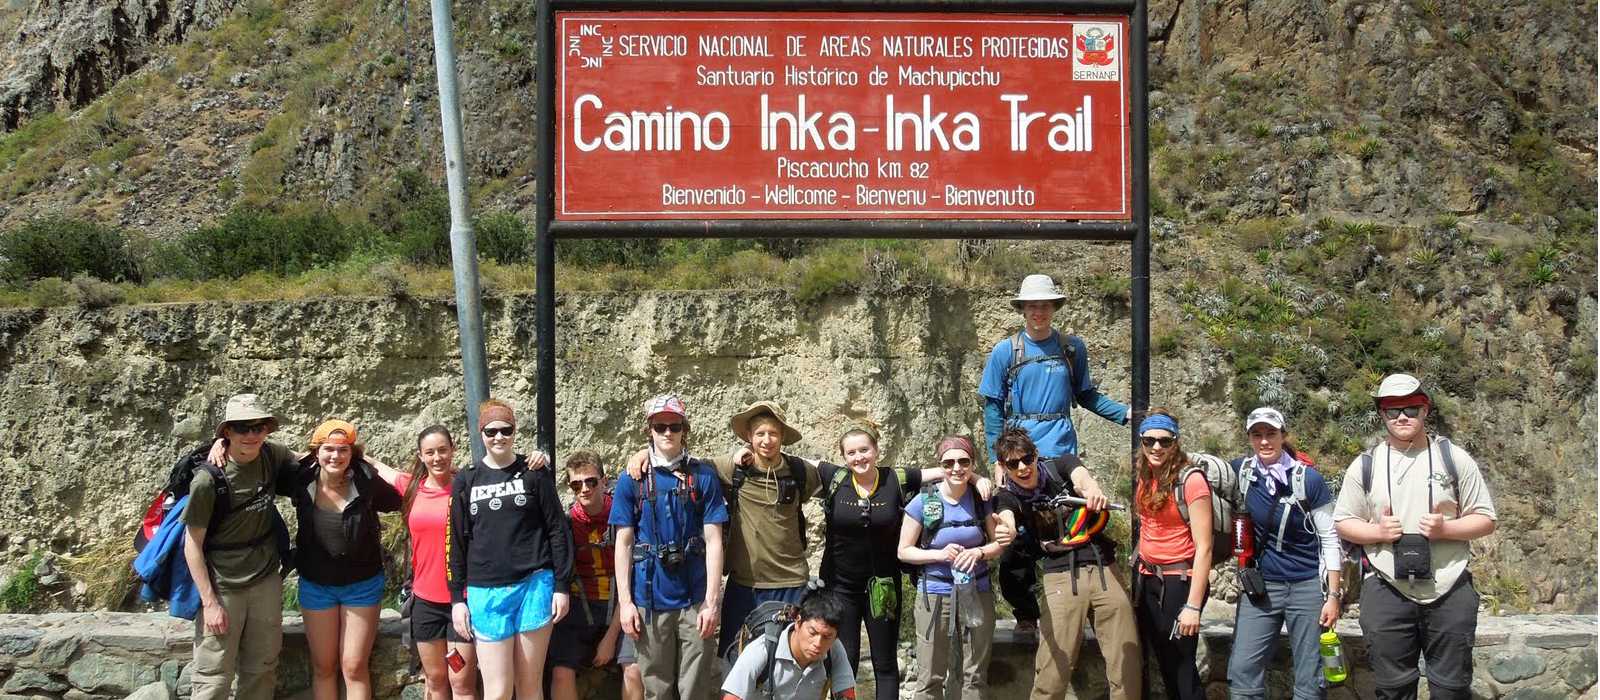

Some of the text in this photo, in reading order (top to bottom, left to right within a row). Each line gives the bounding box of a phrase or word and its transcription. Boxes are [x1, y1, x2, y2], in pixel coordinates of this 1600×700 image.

[580, 24, 602, 36] INC
[569, 35, 581, 57] INC
[601, 35, 613, 57] INC
[618, 35, 1069, 59] SERVICIO NACIONAL DE AREAS NATURALES PROTEGIDAS
[580, 56, 602, 68] INC
[696, 64, 1001, 91] Santuario Histórico de Machupicchu
[1073, 70, 1117, 80] SERNANP
[573, 93, 731, 153] Camino
[760, 93, 856, 152] Inka
[885, 93, 981, 152] Inka
[999, 93, 1093, 152] Trail
[777, 156, 869, 179] Piscacucho
[909, 161, 930, 179] 82
[662, 183, 747, 206] Bienvenido
[764, 183, 838, 206] Wellcome
[855, 183, 927, 207] Bienvenu
[944, 184, 1035, 207] Bienvenuto
